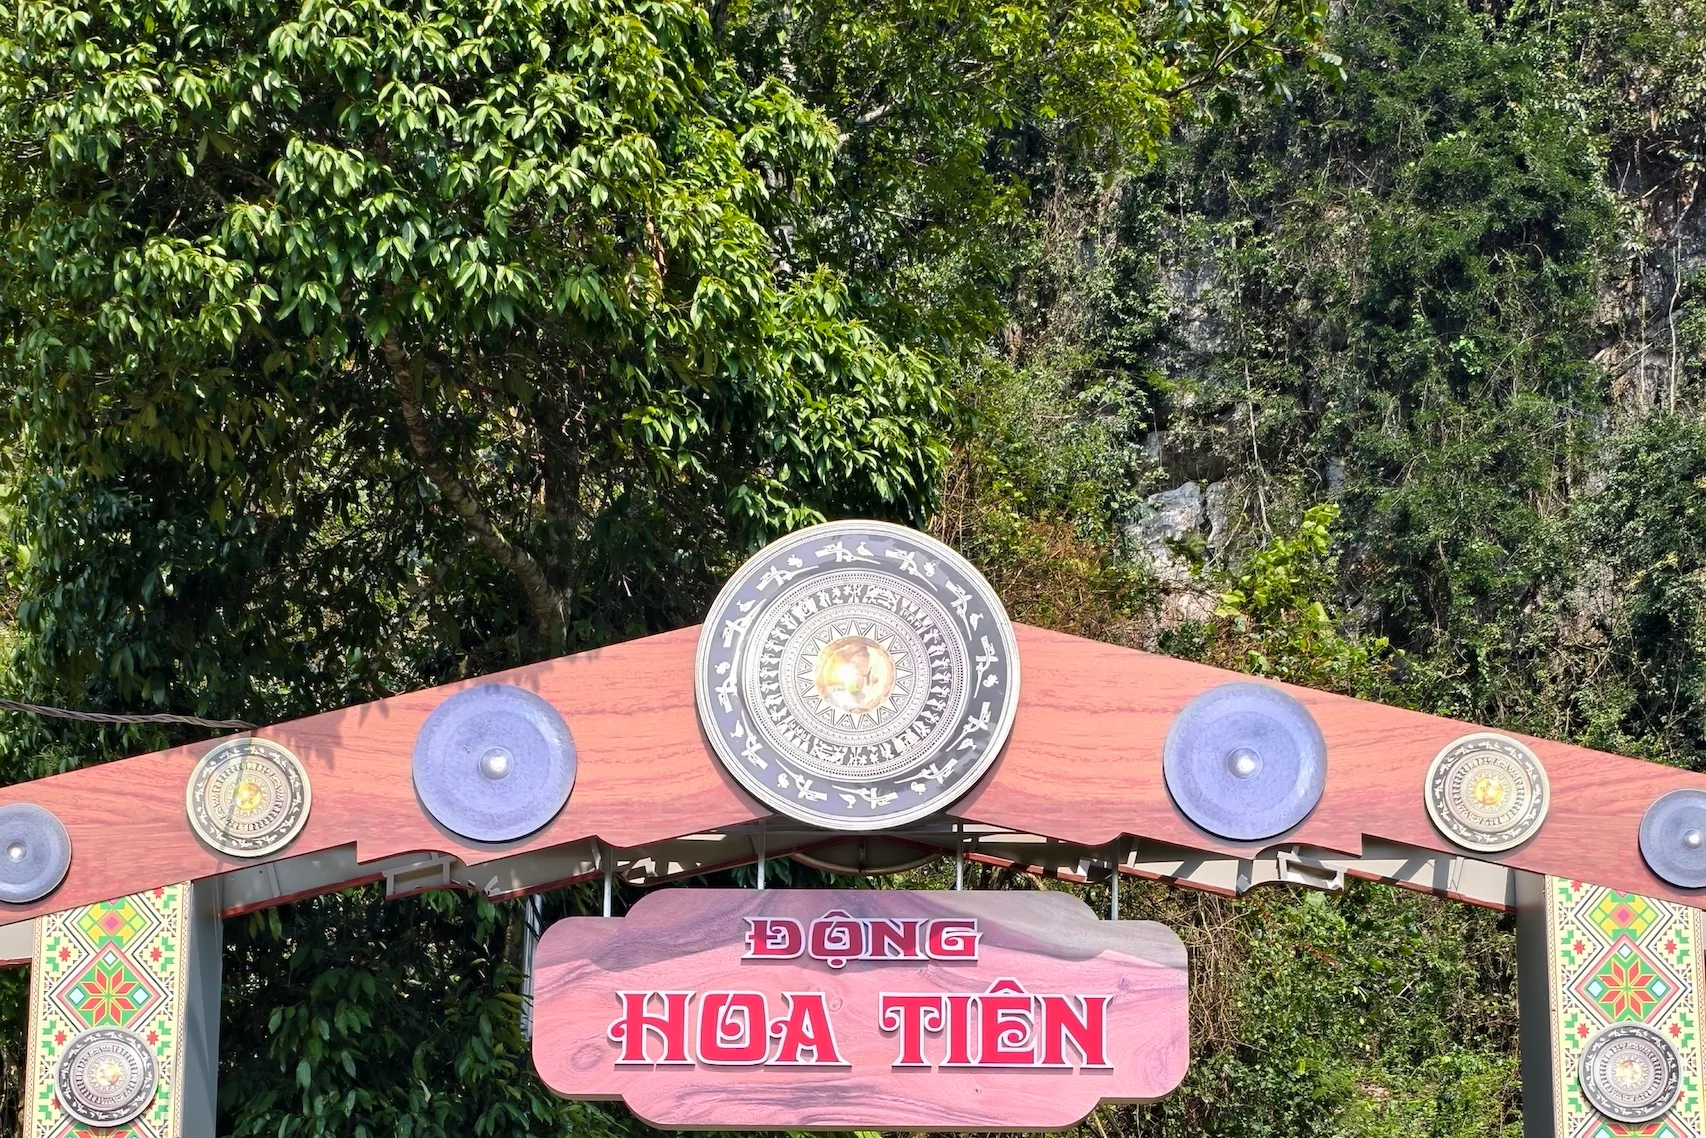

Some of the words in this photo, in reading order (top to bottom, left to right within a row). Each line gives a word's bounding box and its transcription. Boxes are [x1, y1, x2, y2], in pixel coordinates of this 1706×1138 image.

[741, 909, 983, 969] ĐỘNG
[608, 990, 851, 1067] HOA
[879, 977, 1113, 1069] TIÊN
